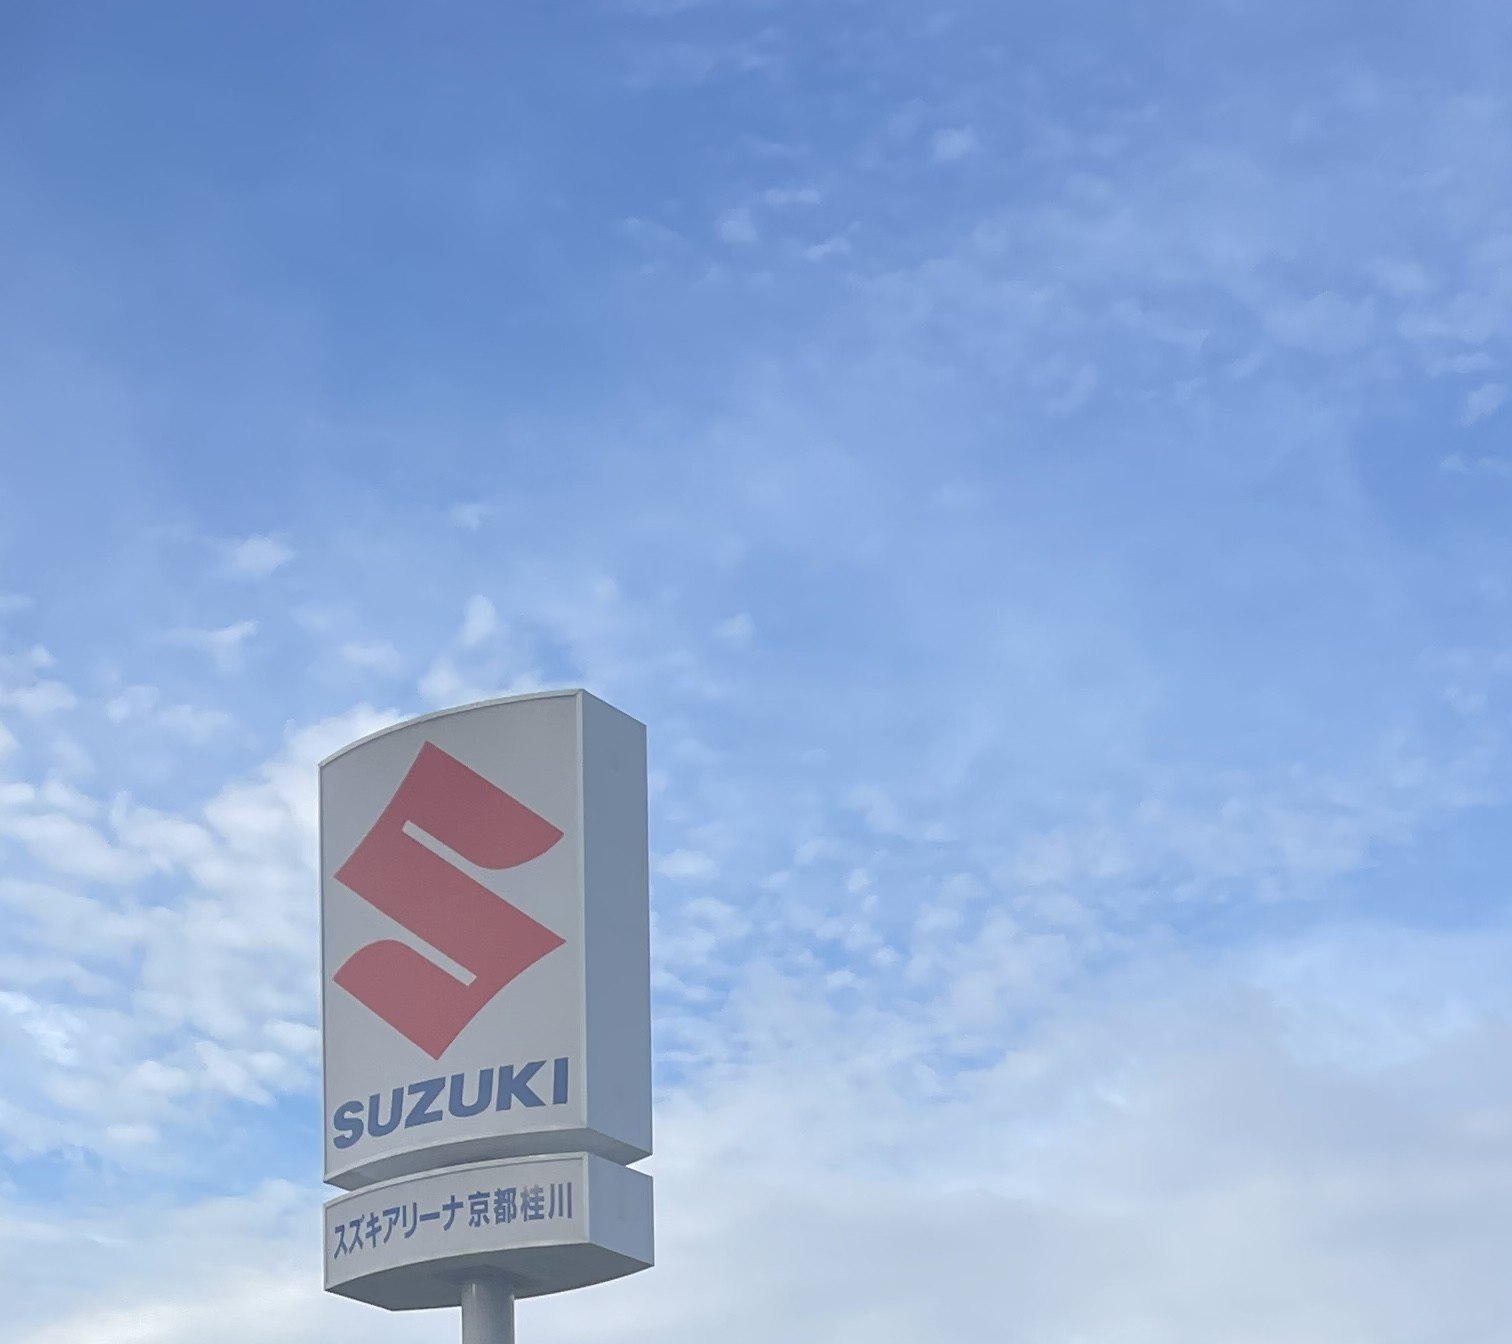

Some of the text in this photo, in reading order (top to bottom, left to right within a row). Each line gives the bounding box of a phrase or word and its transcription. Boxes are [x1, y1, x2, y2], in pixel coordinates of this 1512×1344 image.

[333, 1057, 569, 1149] SUZUKI
[333, 1182, 573, 1260] スズキアリーナ京都桂川
